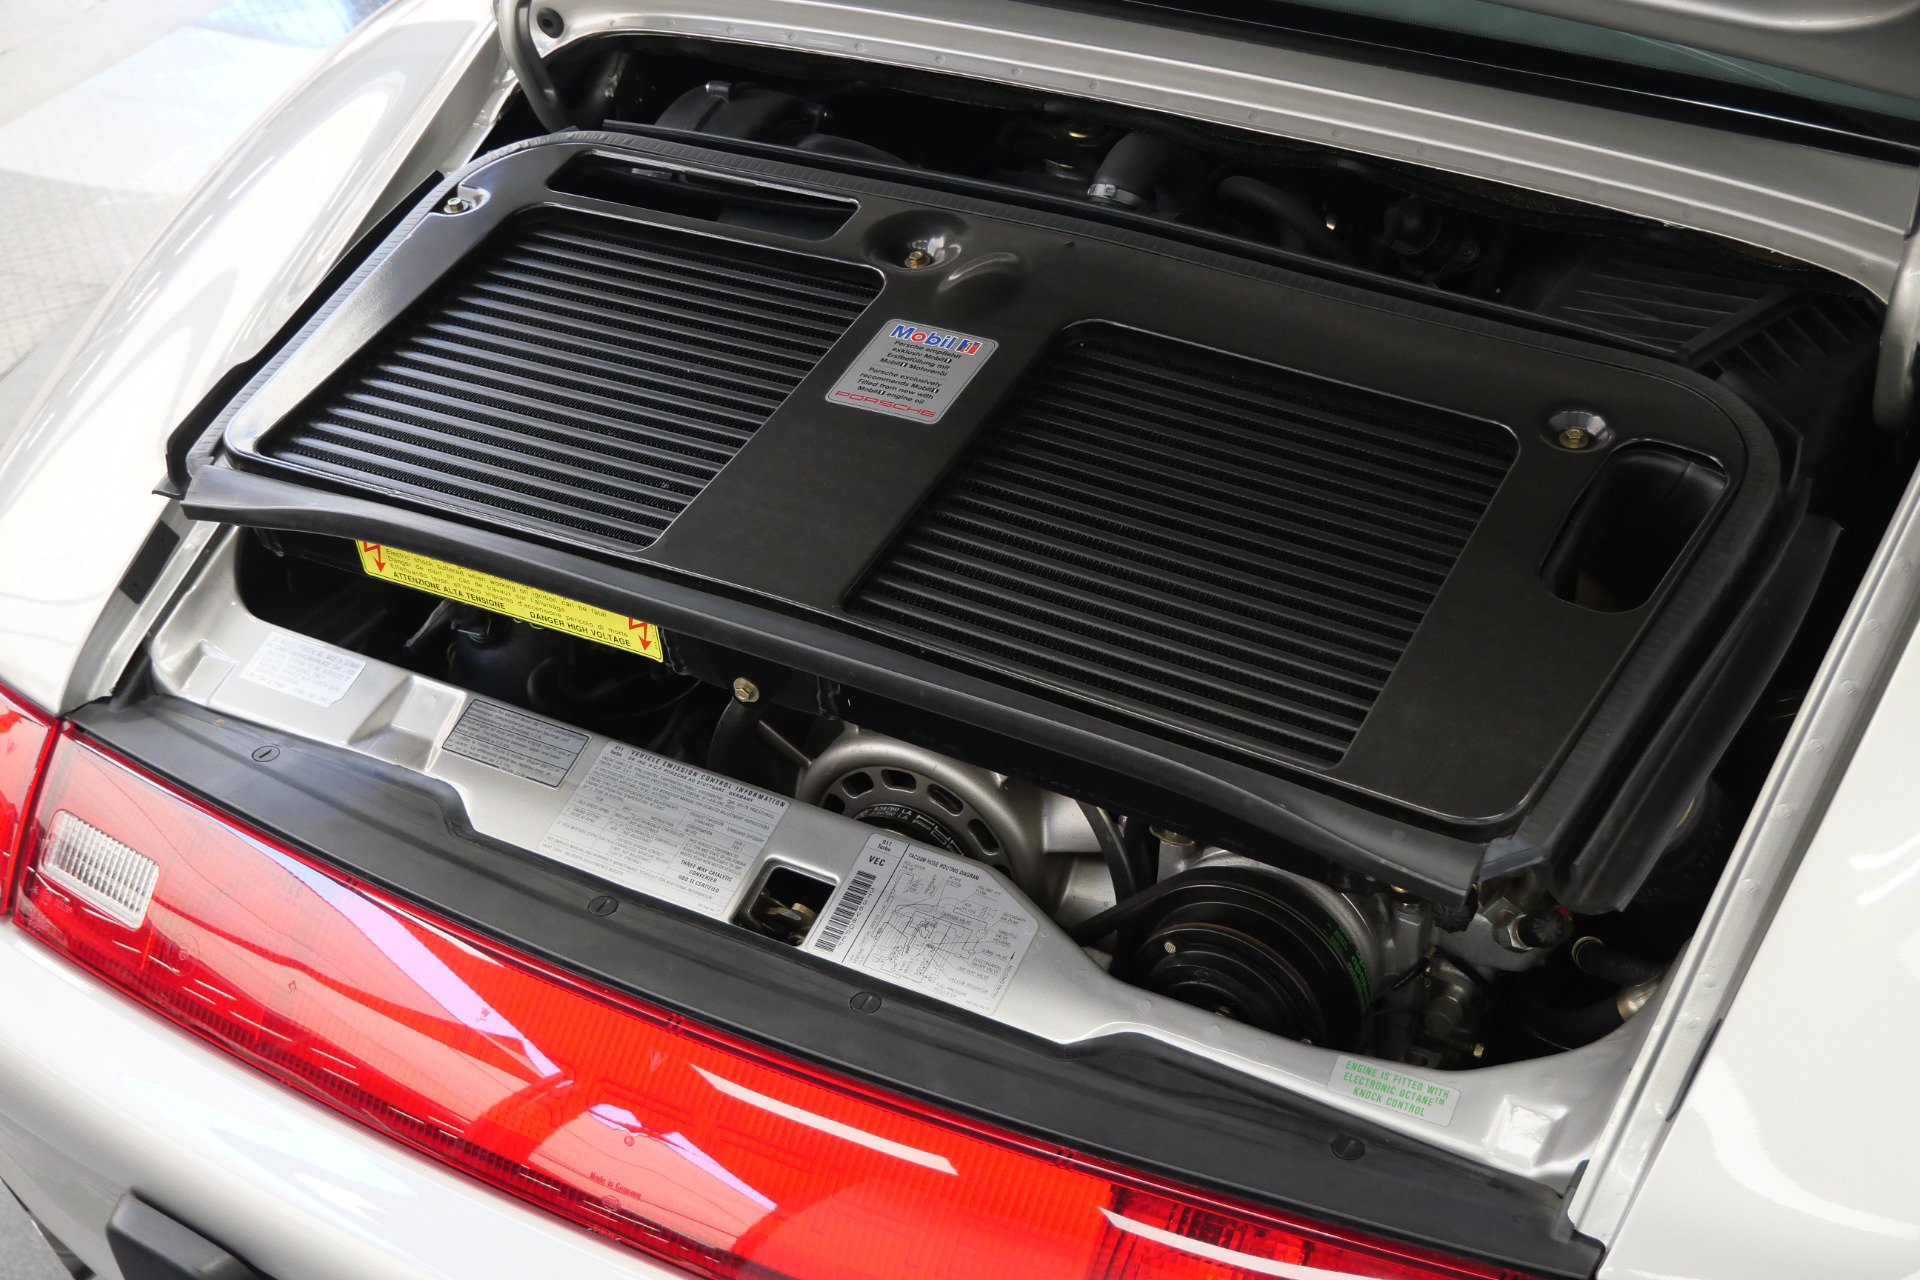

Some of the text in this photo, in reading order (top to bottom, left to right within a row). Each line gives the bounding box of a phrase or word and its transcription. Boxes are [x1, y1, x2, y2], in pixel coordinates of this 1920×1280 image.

[889, 324, 982, 354] Mobil 1
[891, 347, 923, 356] exklusiv
[893, 341, 961, 358] Porsche empfiehlt
[860, 372, 909, 386] recommends
[868, 367, 942, 387] Porsche exclusively
[835, 390, 936, 417] PORSCHE
[886, 392, 913, 401] engine
[393, 571, 504, 609] ATTENZIONE ALTA TENSIONE
[530, 611, 630, 646] DANGER HIGH VOLTAGE
[630, 750, 660, 763] VEHICLE
[661, 761, 698, 777] EMISSION
[699, 774, 732, 788] CONTROL
[734, 786, 786, 807] INFORMATION
[662, 768, 687, 779] PORSCHE
[696, 780, 725, 792] STUTTGART
[727, 791, 753, 802] GERMANY
[680, 859, 696, 868] THREE
[707, 869, 733, 882] CATALYTIC
[867, 855, 886, 866] VEC
[908, 852, 980, 880] VACUUM HOSE ROUTING DIAGRAM
[688, 869, 718, 883] CONVERTER
[694, 880, 720, 893] CERTIFIED
[1343, 1072, 1396, 1094] ELECTRONIC
[1345, 1061, 1449, 1098] ENGINE IS FITTED WITH
[1352, 1087, 1425, 1115] KNOCK CONTROL
[590, 1171, 641, 1200] Made in Germany
